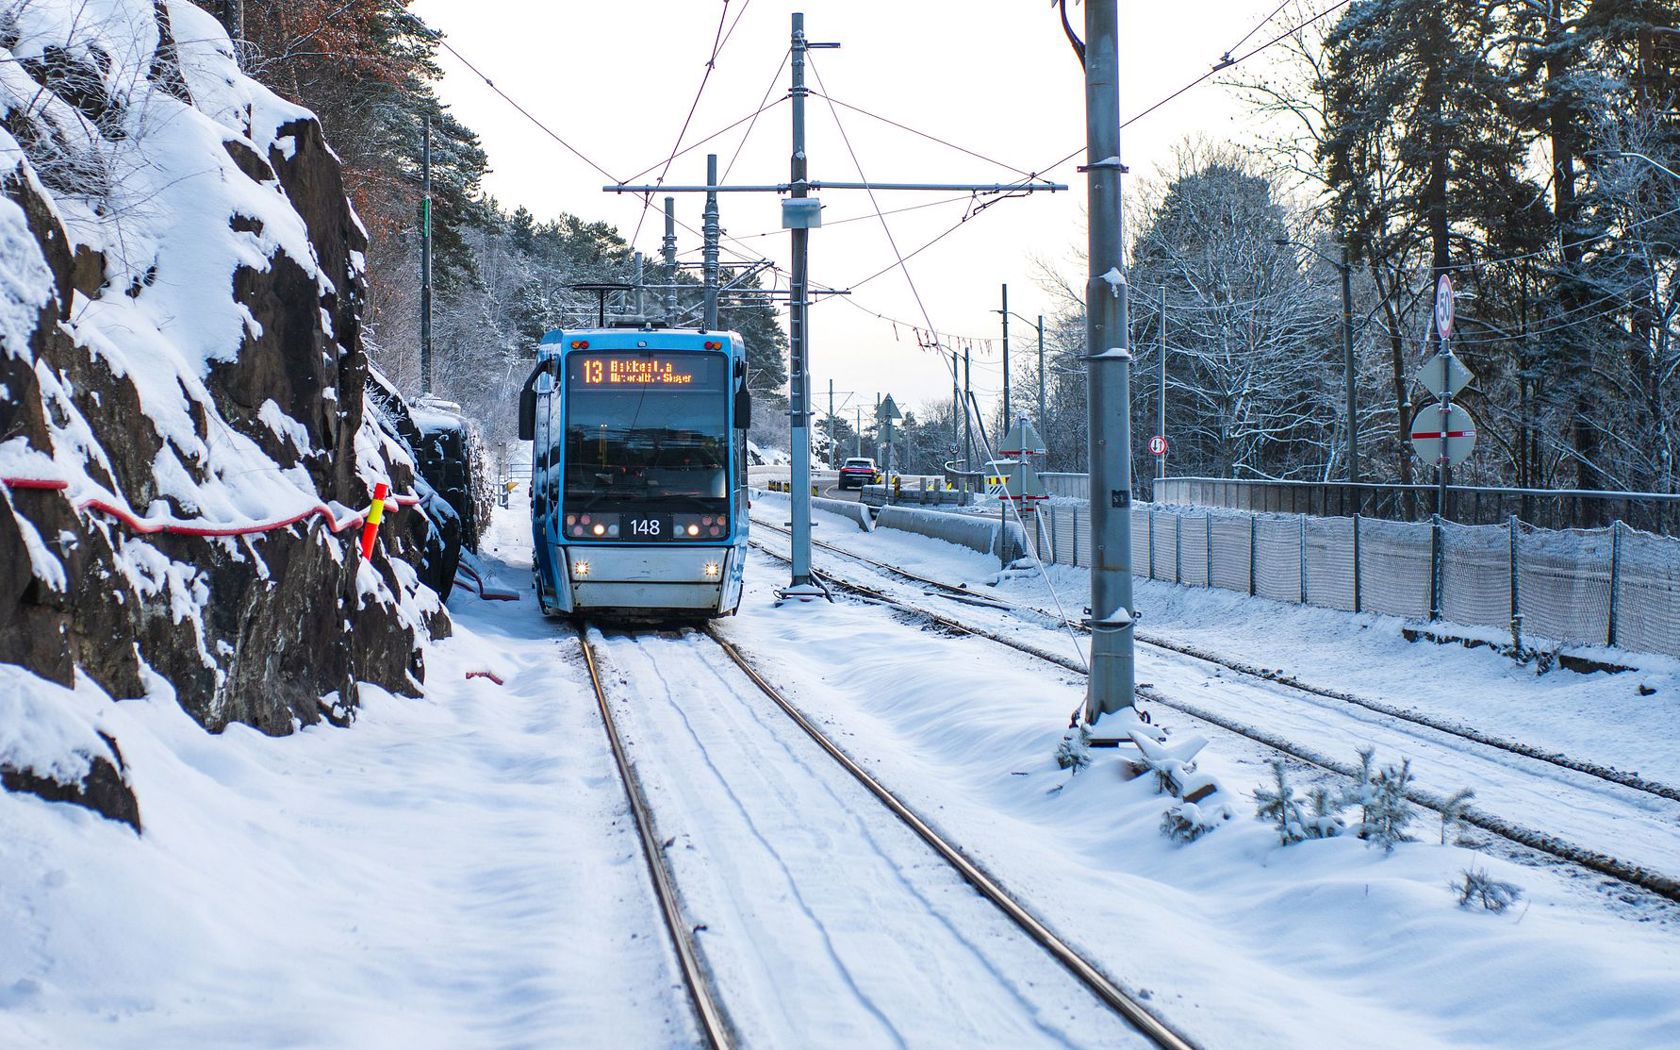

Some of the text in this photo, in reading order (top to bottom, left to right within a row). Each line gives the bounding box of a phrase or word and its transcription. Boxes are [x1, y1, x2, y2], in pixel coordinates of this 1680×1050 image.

[1440, 291, 1450, 321] 50
[583, 360, 602, 383] 13
[630, 519, 660, 535] 148
